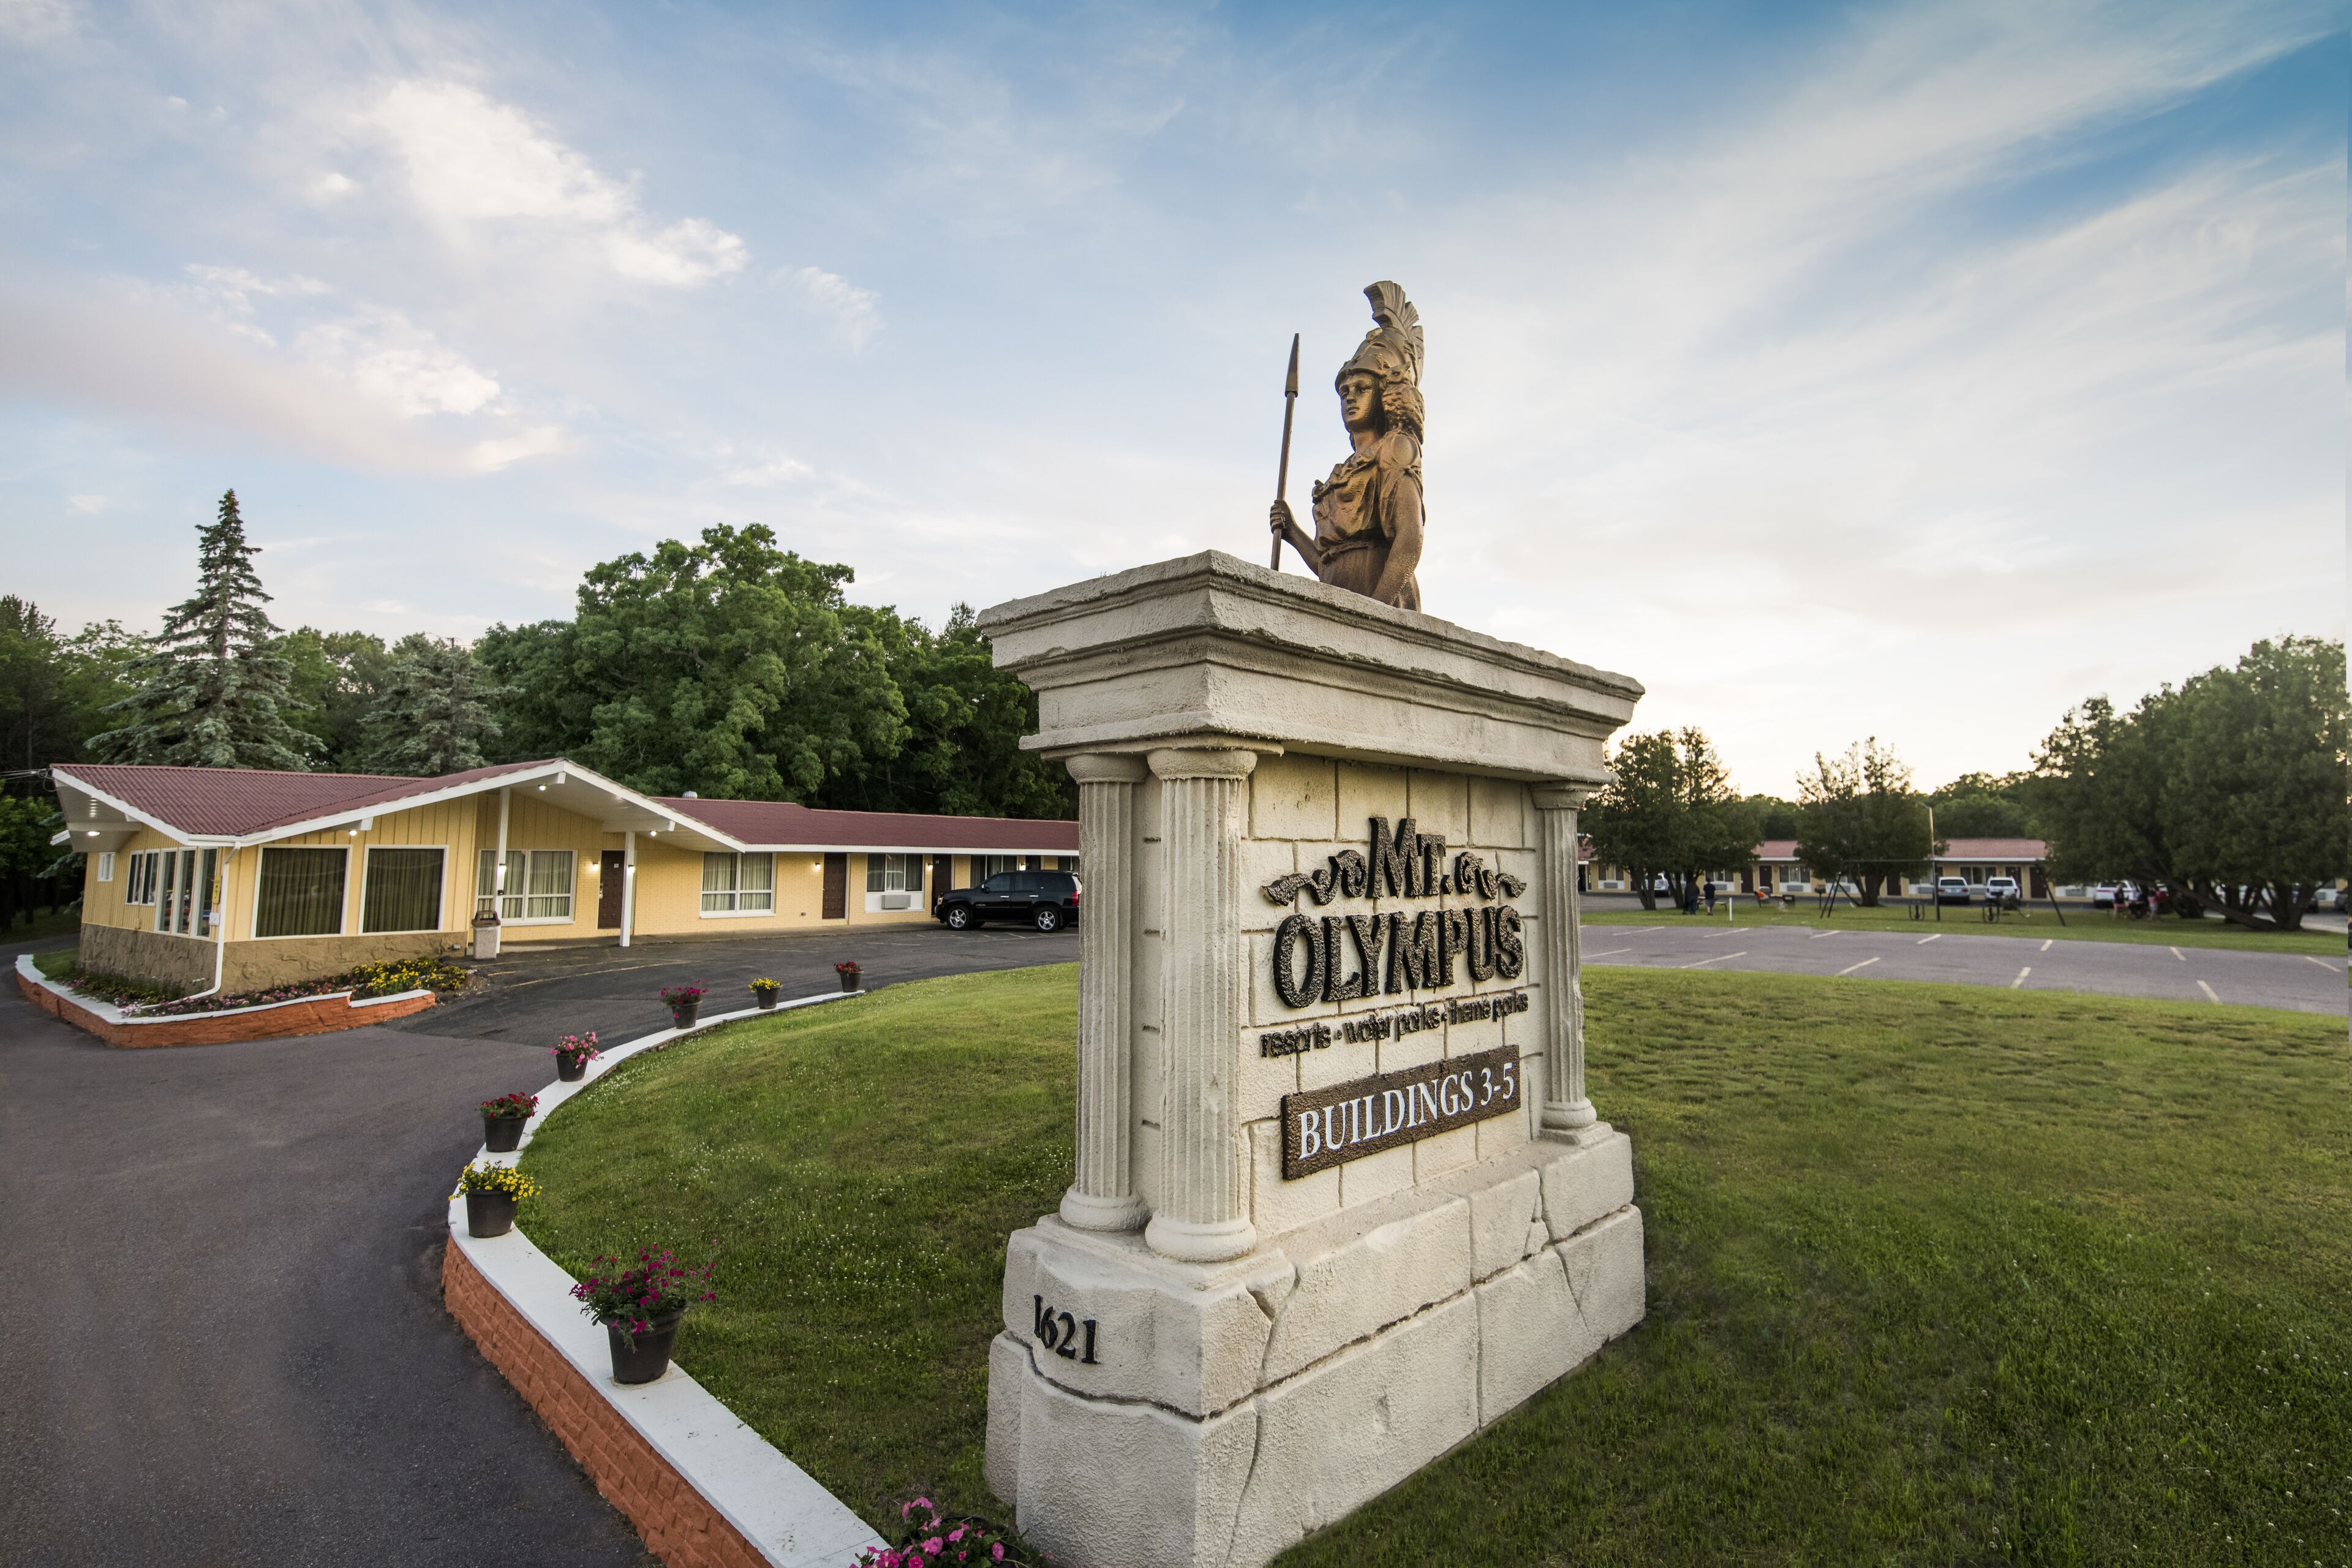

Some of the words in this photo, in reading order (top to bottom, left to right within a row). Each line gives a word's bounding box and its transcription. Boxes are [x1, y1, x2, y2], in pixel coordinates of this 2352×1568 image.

[1273, 905, 1525, 1008] OLYMPUS
[1261, 1022, 1332, 1058] resorts
[1343, 1014, 1393, 1044] water
[1394, 1003, 1441, 1042] parks
[1448, 998, 1491, 1025] theme
[1492, 990, 1529, 1022] parks
[1298, 1071, 1474, 1159] BUILDINGS
[1480, 1062, 1515, 1106] 3-5
[1033, 1294, 1098, 1364] 1621
